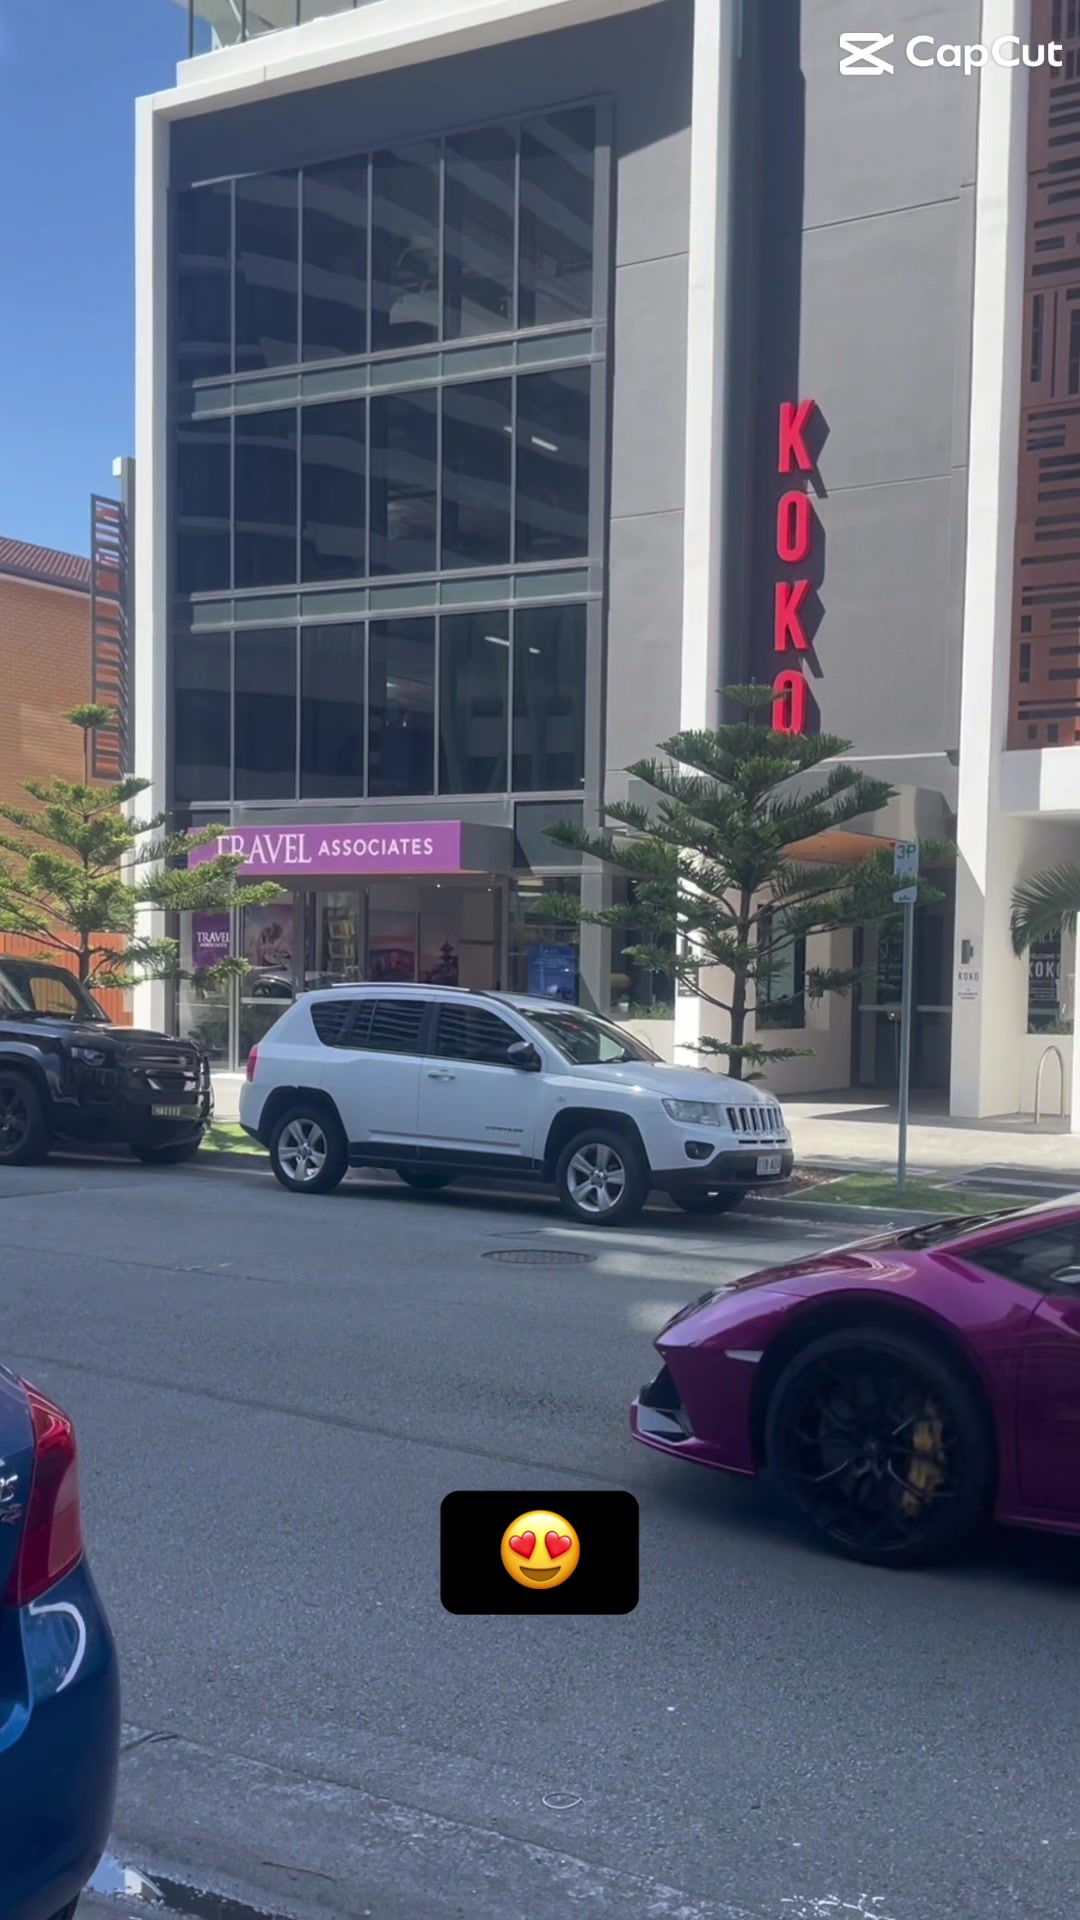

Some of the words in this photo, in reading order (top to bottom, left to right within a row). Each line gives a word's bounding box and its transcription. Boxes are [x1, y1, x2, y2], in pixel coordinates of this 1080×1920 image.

[772, 399, 816, 735] KOKO
[216, 833, 312, 864] TRAVEL
[318, 837, 433, 857] ASSOCIATES
[896, 844, 917, 860] 3P
[196, 932, 230, 943] TRAVEL
[958, 972, 979, 981] KOKO
